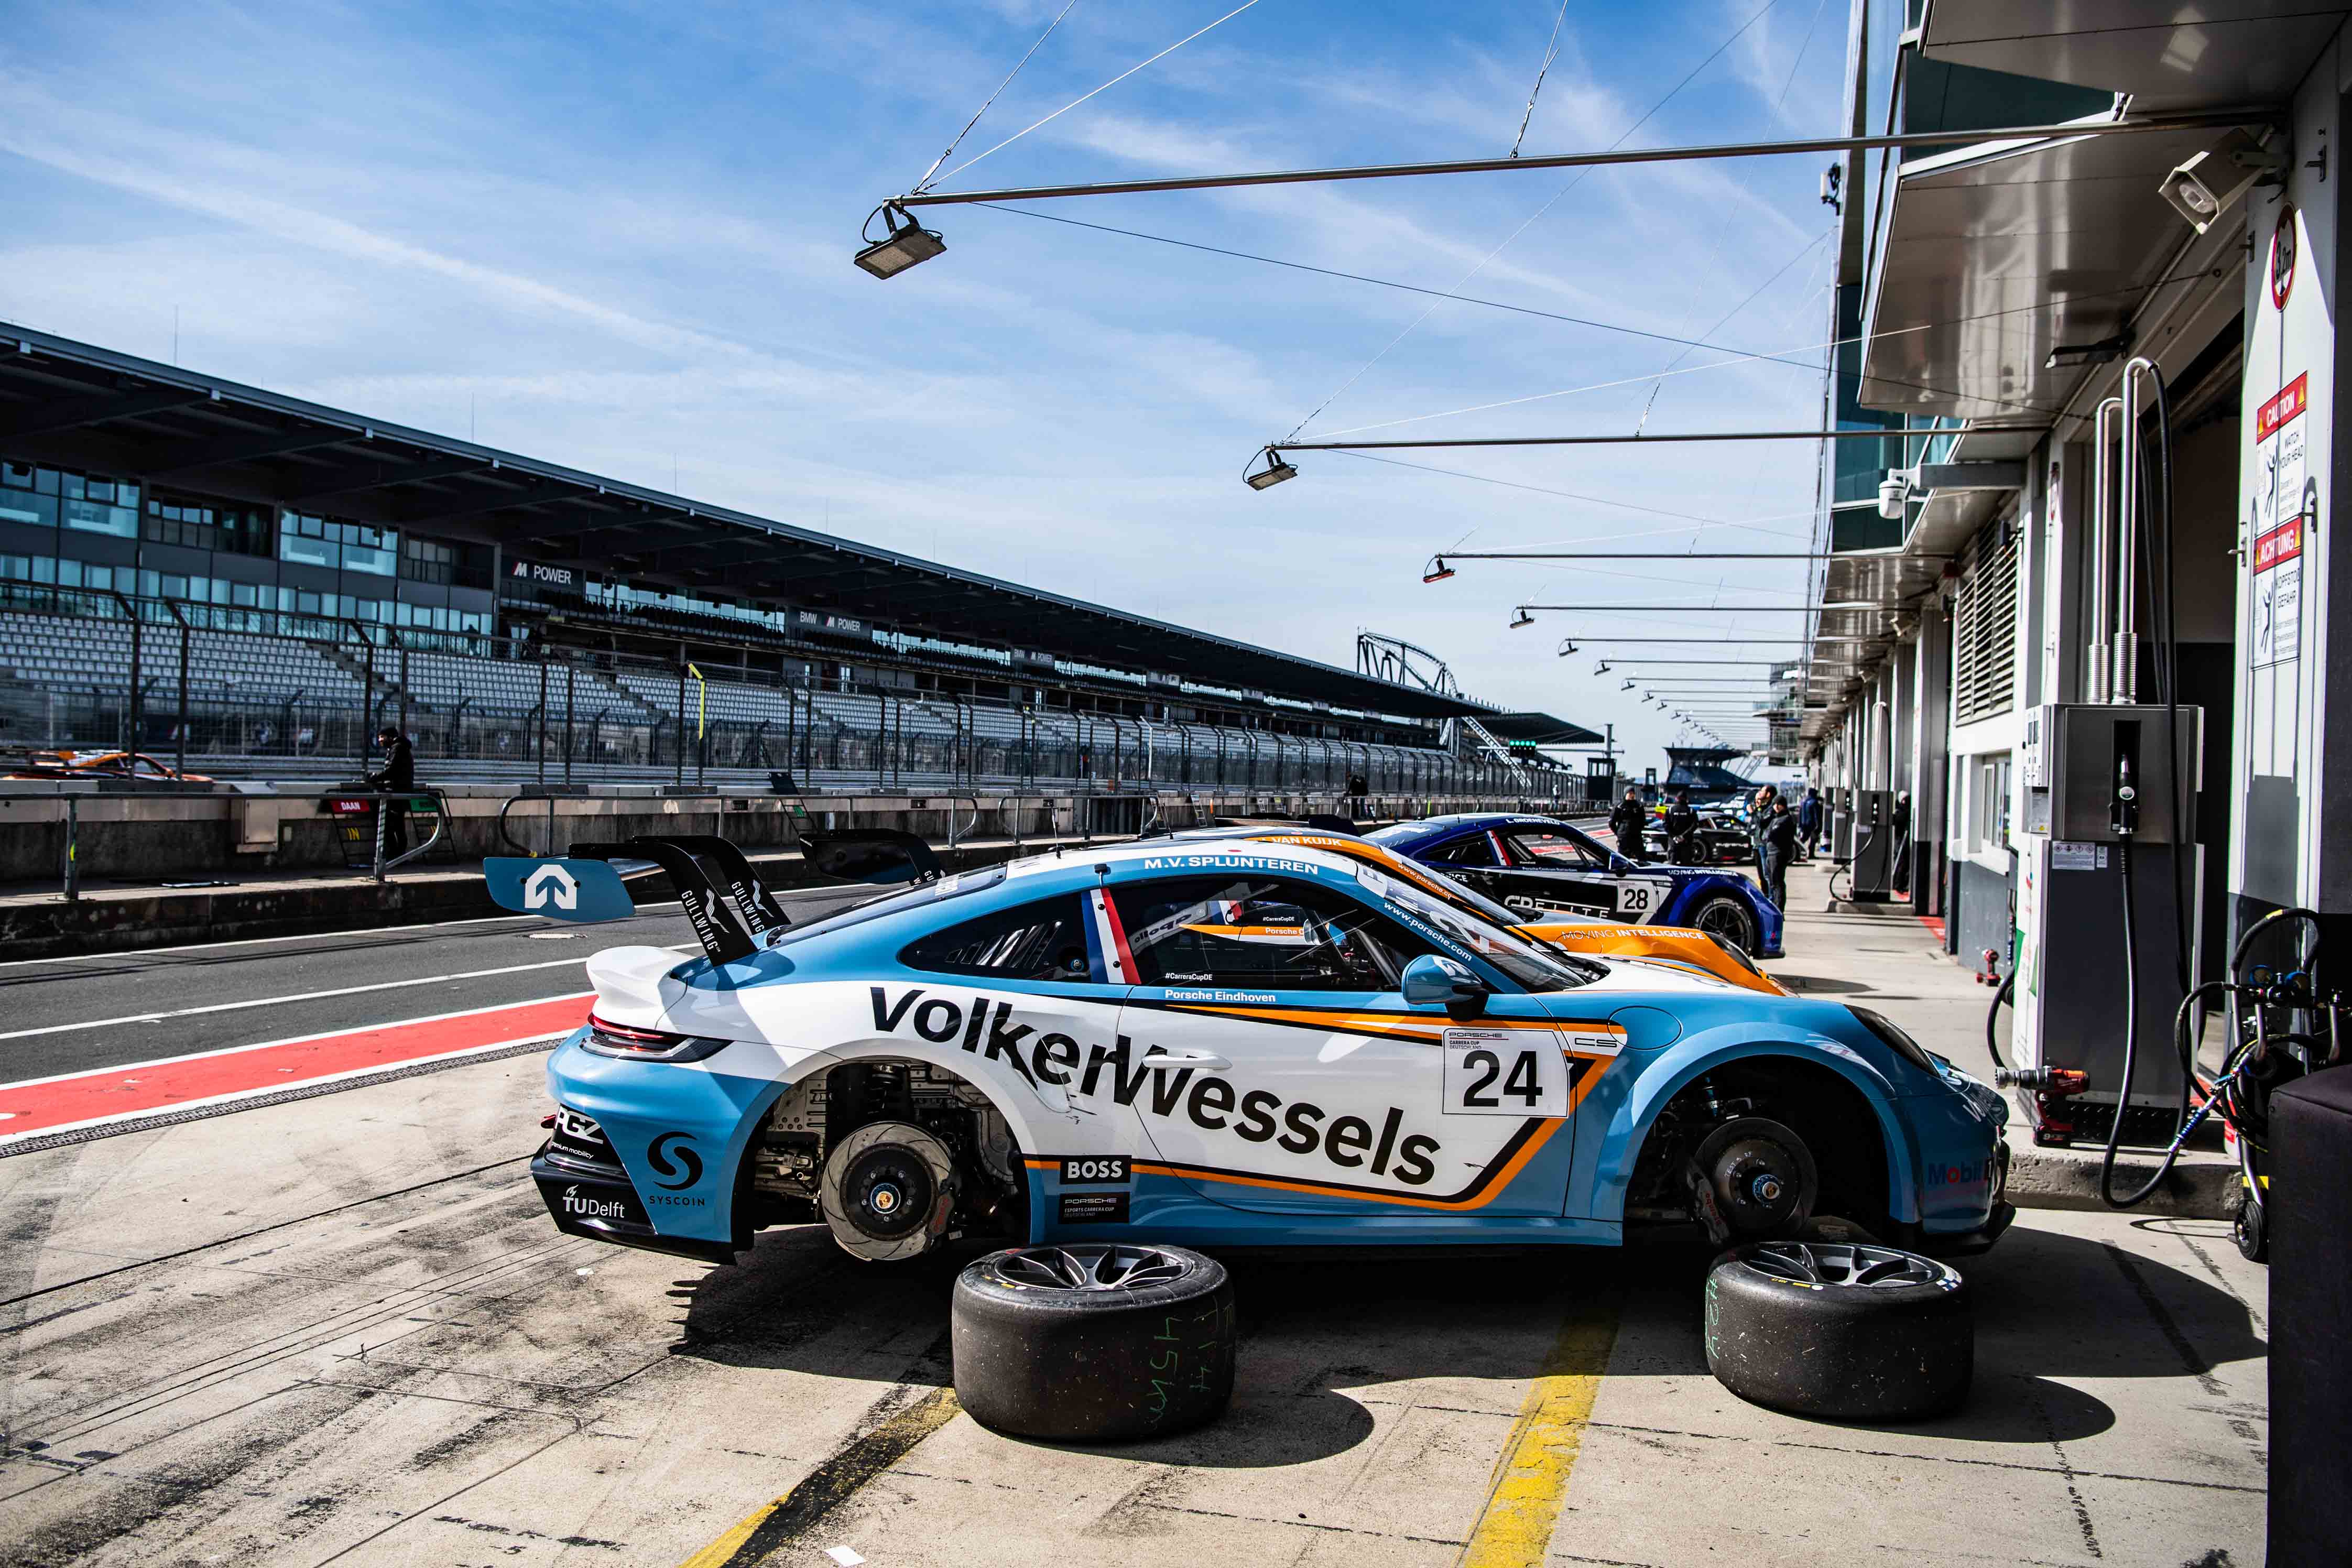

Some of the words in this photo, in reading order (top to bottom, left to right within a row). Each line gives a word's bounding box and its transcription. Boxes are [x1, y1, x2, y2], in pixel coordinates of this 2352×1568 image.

[2266, 390, 2295, 428] CAUTION
[2284, 431, 2299, 449] WATCH
[2260, 529, 2294, 564] ACHTUNG
[533, 565, 571, 584] POWER
[2277, 590, 2296, 608] GEFAHR
[800, 611, 818, 624] BMW
[838, 618, 860, 631] POWER
[341, 801, 361, 810] DAAN
[347, 827, 360, 840] IN
[1272, 837, 1300, 845] VAN
[1302, 837, 1342, 847] KUIJK
[1144, 857, 1185, 869] M.V.
[1189, 856, 1319, 875] SPLUNTEREN
[1397, 863, 1453, 899] www.porsche.co
[732, 881, 765, 932] GULLWING
[1624, 889, 1648, 910] 28
[681, 890, 718, 950] GULLWING
[1384, 902, 1472, 962] www.porsche.com
[1562, 930, 1614, 939] MOVING
[1617, 930, 1705, 940] INTELLIGENCE
[1165, 973, 1213, 981] #CarreraCupDE
[1165, 989, 1212, 1000] Porsche
[1215, 992, 1276, 1003] Eindhoven
[869, 986, 1440, 1185] VolkerWessels
[1463, 1050, 1543, 1107] 24
[569, 1148, 594, 1159] mobility
[1068, 1161, 1122, 1178] BOSS
[649, 1195, 705, 1206] SYSCOIN
